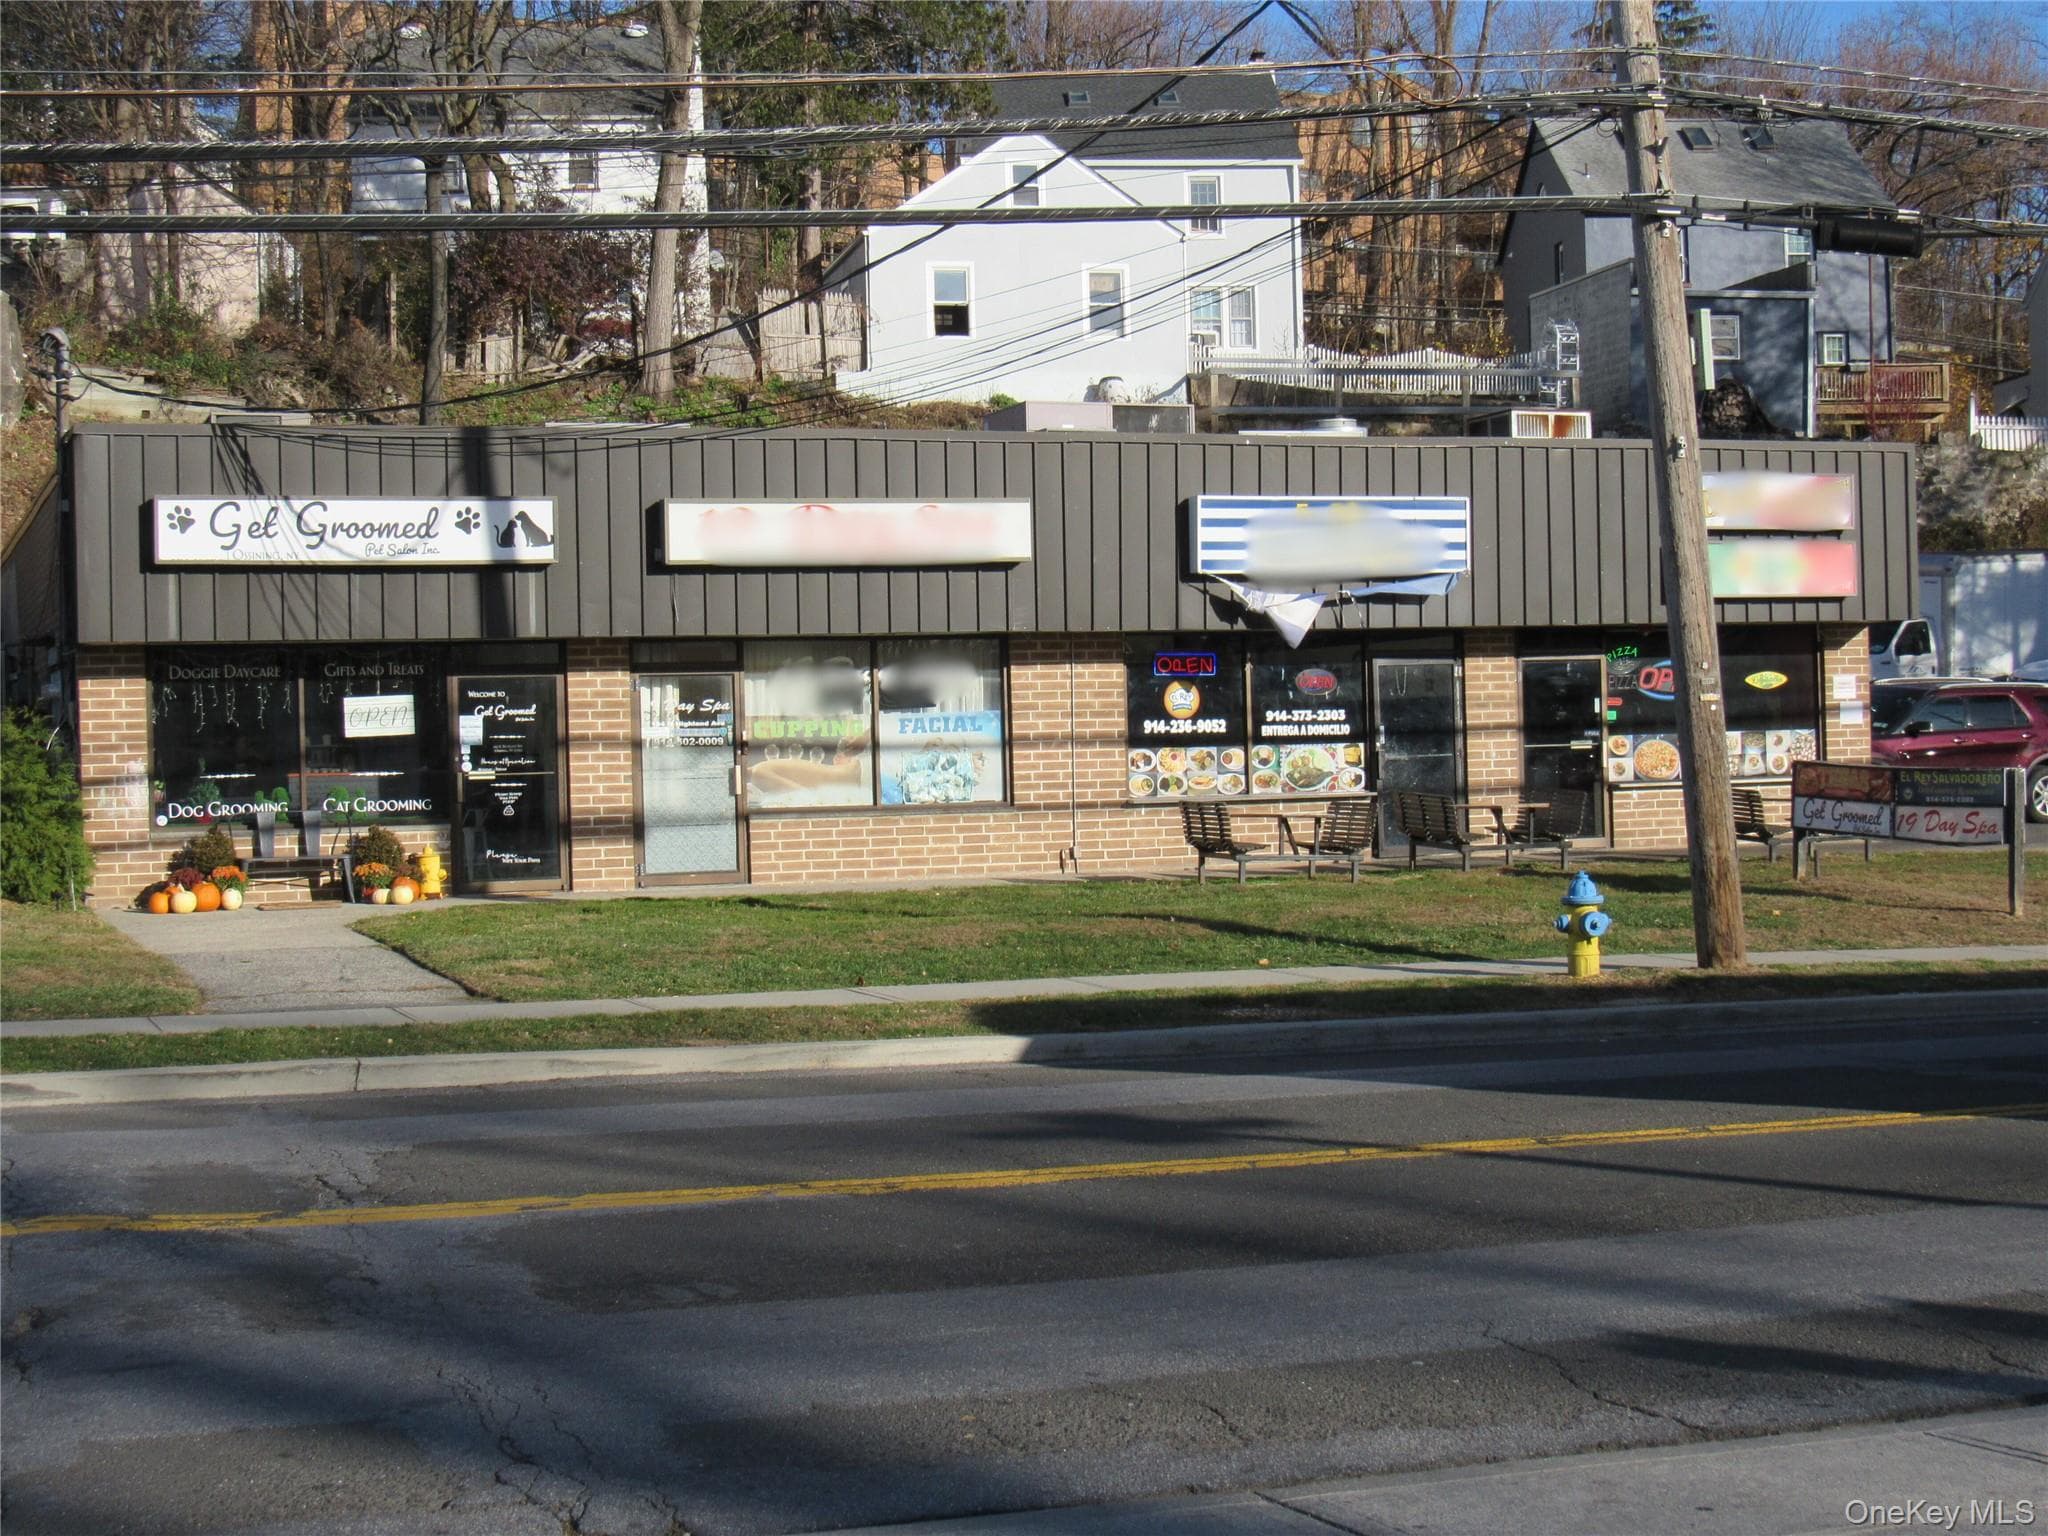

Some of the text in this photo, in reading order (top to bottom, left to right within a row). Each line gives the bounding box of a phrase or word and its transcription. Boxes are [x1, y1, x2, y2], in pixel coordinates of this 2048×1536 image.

[209, 501, 440, 550] Get Groomed
[365, 542, 440, 557] Pet Salon Inc.
[1606, 646, 1639, 663] PIZZA
[169, 664, 281, 679] DOGGIE DAYCARE
[387, 662, 424, 676] TREATS
[1157, 656, 1213, 673] OPEN
[1639, 668, 1676, 692] OP
[495, 704, 537, 721] Groomed
[699, 699, 731, 714] Spa
[350, 705, 408, 728] OPEN
[753, 719, 865, 740] CUPPING
[898, 716, 983, 735] FACIAL
[1143, 719, 1227, 734] 914-236-9052
[1261, 724, 1351, 737] ENTREGA A DOMICILIO
[168, 801, 288, 819] DOG GROOMING
[323, 797, 432, 813] CAT GROOMING
[1803, 798, 1884, 830] Get Groomed
[1896, 810, 1999, 839] 19 Day Spa
